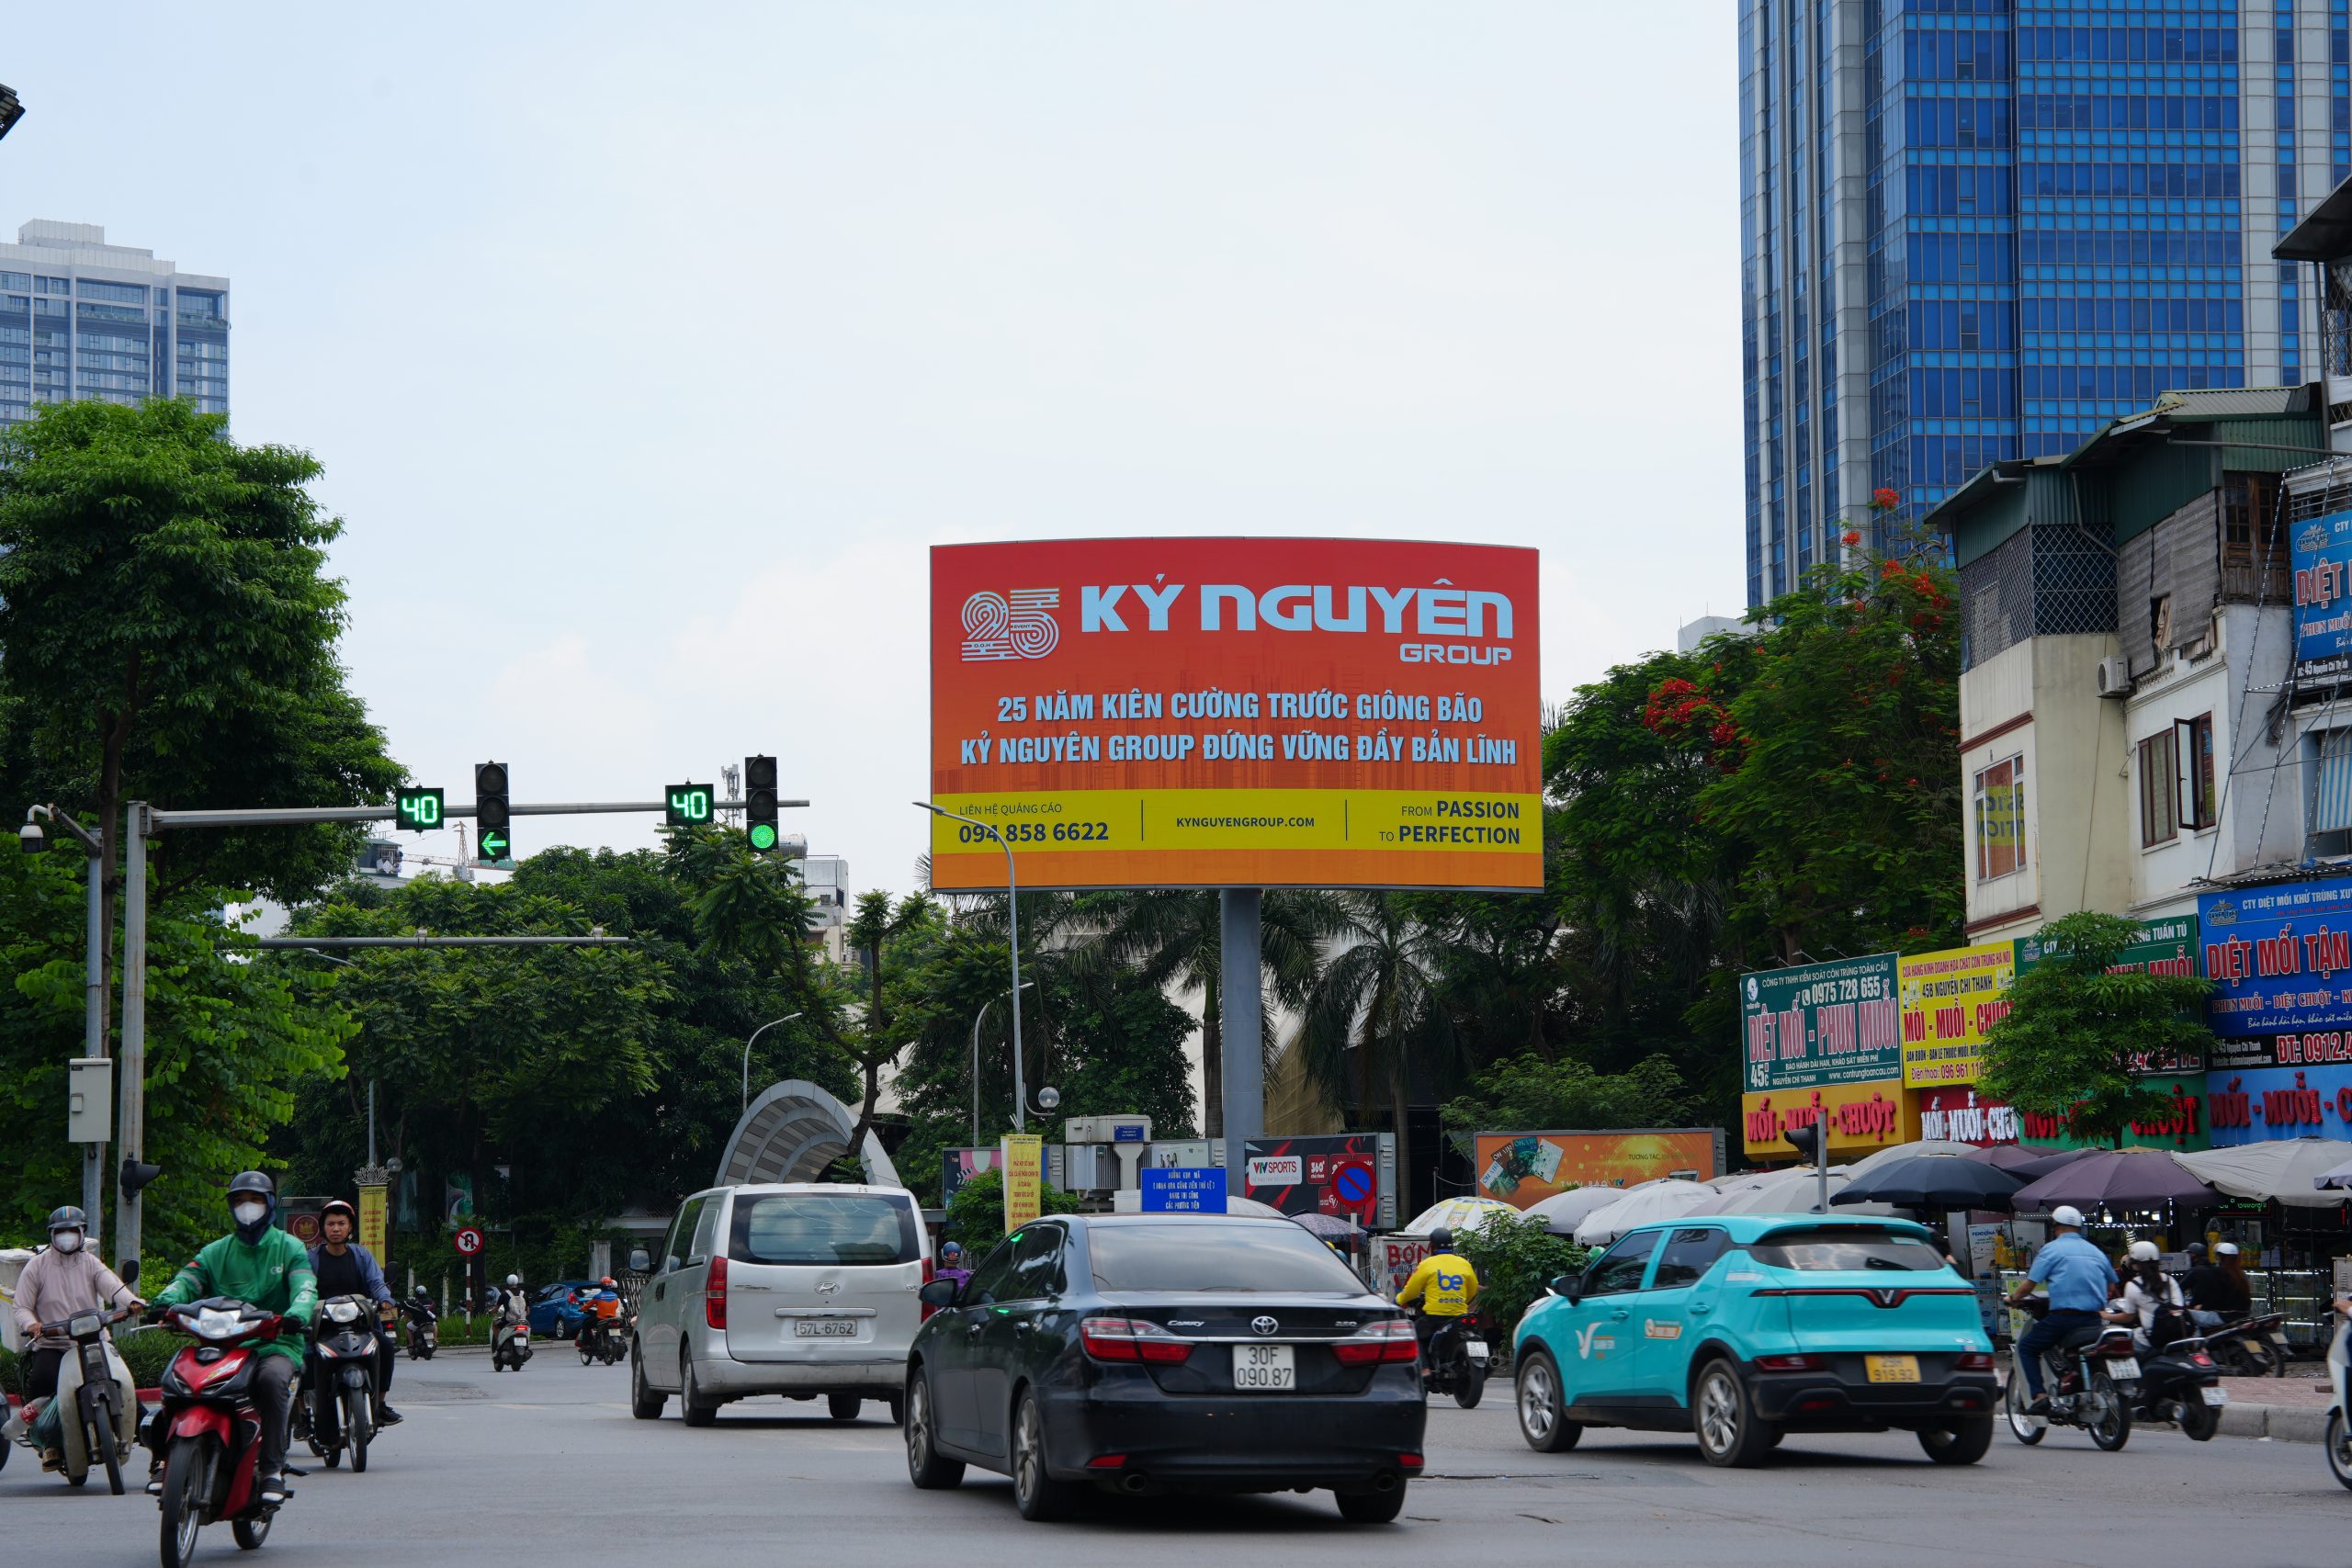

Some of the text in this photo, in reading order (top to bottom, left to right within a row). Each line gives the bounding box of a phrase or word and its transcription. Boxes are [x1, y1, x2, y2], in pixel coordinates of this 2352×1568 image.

[2335, 520, 2349, 533] CTY
[2295, 558, 2343, 609] DIỆT
[961, 588, 1059, 662] 25
[2301, 620, 2327, 637] PHUN
[1399, 643, 1512, 665] GROUP
[2304, 660, 2312, 675] 45
[998, 686, 1483, 723] 25 NĂM KIÊN CƯỜNG TRƯỚC GIÔNG BÃO
[961, 727, 1516, 765] KỶ NGUYÊN GROUP ĐỨNG VỮNG ĐẦY BẢN LĨNH
[401, 795, 437, 823] 40
[672, 791, 707, 819] 40
[959, 801, 1062, 816] LIÊN HỆ QUẢNG CÁO
[1401, 800, 1520, 819] FROM PASSION
[958, 822, 1109, 843] 094 858 6622
[1176, 817, 1315, 828] KYNGUYENGROUP.COM
[1379, 825, 1521, 844] TO PERFECTION
[2242, 899, 2256, 910] CTY
[2257, 897, 2275, 909] DIỆT
[2277, 892, 2292, 907] MỐI
[2293, 889, 2311, 905] KHỬ
[2312, 888, 2338, 901] TRÙNG
[2152, 921, 2175, 941] TUẤN
[2176, 921, 2188, 937] TÚ
[2206, 923, 2351, 987] DIỆT MỐI TẬN
[1762, 961, 1888, 987] CÔNG TY TNHH KIỂM SOÁT CÔN TRÙNG TOÀN CẦU
[1812, 976, 1880, 1004] 0975 728 655
[1922, 974, 1992, 998] 45B NGUYỄN CHÍ THANH
[2212, 988, 2332, 1014] PHUN MUỖI DIỆT CHUỘT
[1747, 978, 1898, 1072] DIỆT MỐI PHUN MUỖI
[1904, 998, 1966, 1043] MỐI MUỖI
[2262, 1016, 2278, 1027] hành
[2276, 1034, 2301, 1064] ĐT:
[1785, 1059, 1795, 1071] BẢO
[1796, 1058, 1810, 1069] HÀNH
[1810, 1057, 1819, 1068] DÀI
[1846, 1055, 1856, 1065] SÁT
[1870, 1053, 1879, 1063] PHÍ
[1912, 1067, 1925, 1081] Điện
[1940, 1064, 1954, 1079] 096
[1956, 1063, 1968, 1077] 961
[1801, 1075, 1815, 1084] THANH
[2208, 1071, 2323, 1128] MỐI MUỖI
[1747, 1091, 1896, 1142] MỐI CHUỘT
[1253, 1161, 1297, 1174] VTV SPORTS
[1437, 1269, 1464, 1291] be
[1249, 1347, 1279, 1365] 30F
[1237, 1368, 1292, 1387] 090.87
